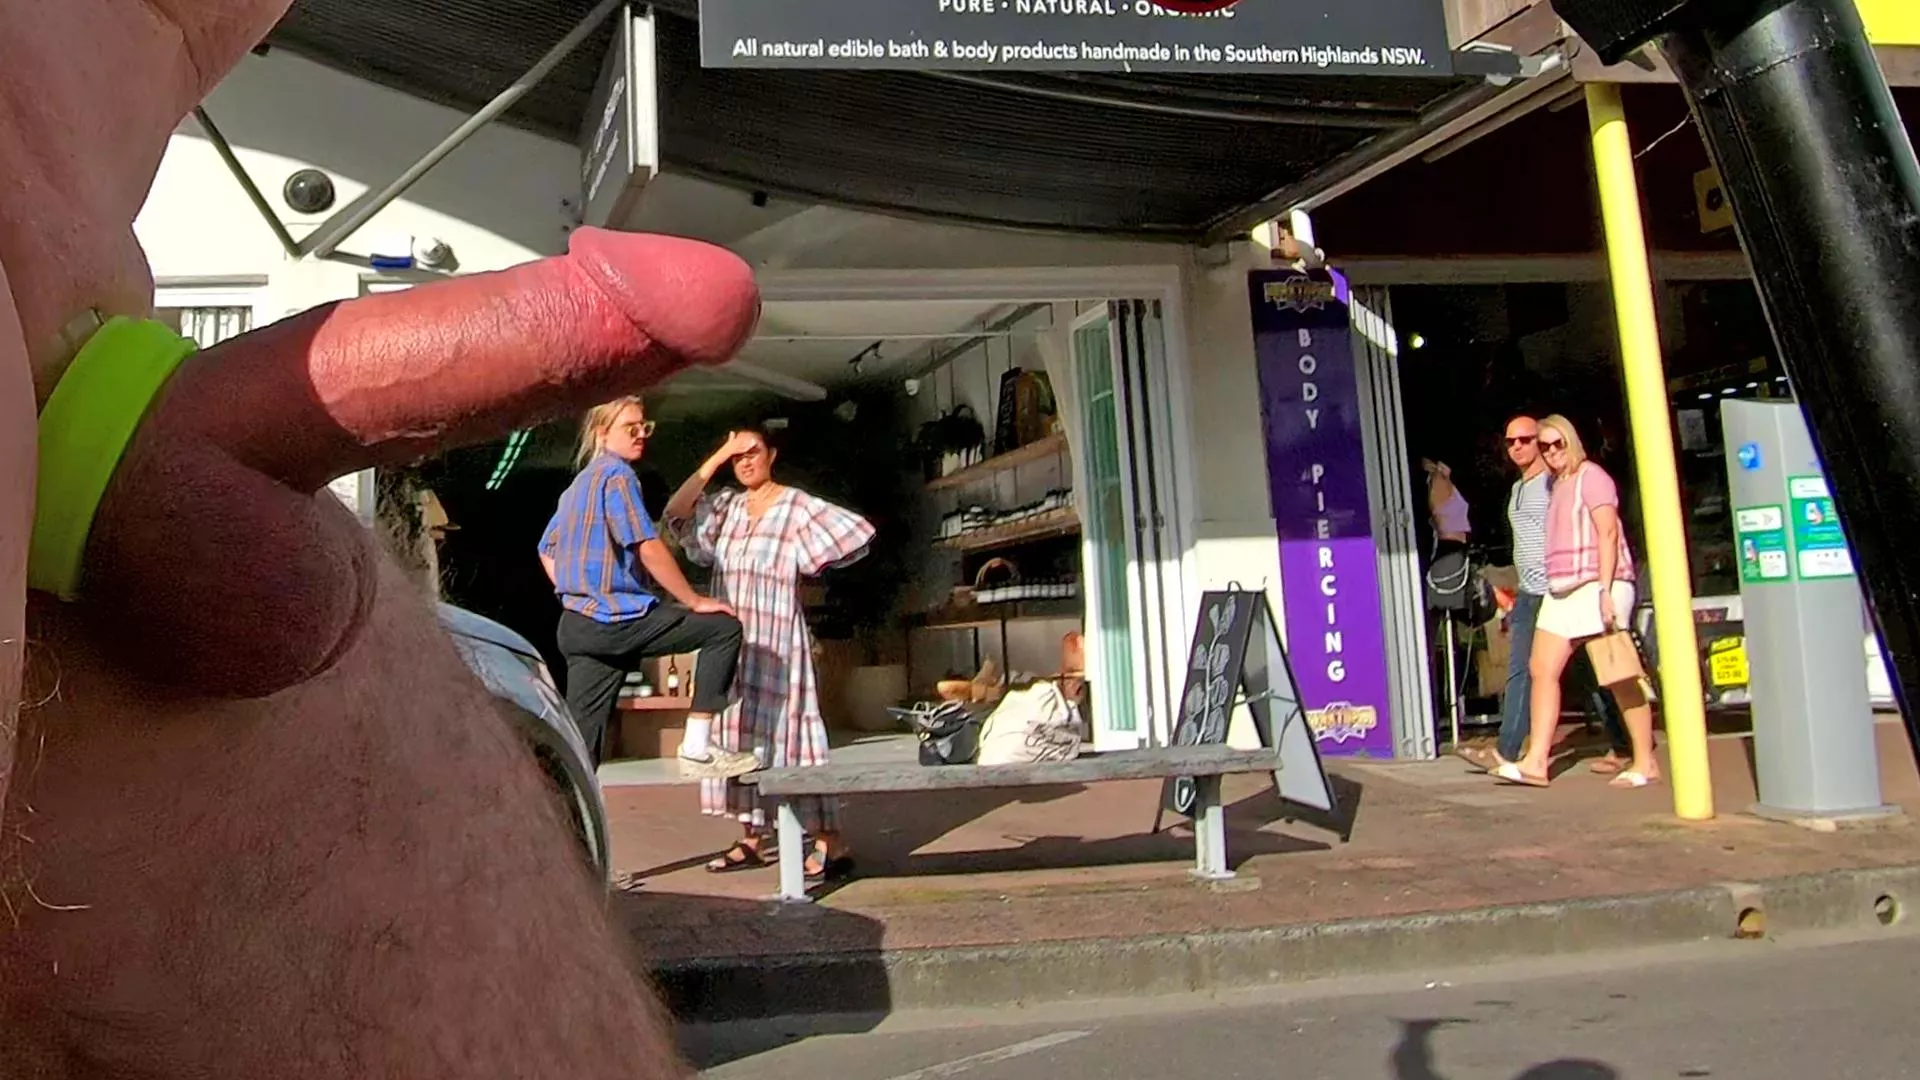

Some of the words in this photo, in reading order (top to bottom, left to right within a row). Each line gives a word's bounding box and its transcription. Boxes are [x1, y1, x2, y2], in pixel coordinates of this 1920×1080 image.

[939, 0, 995, 13] PURE
[1016, 0, 1116, 15] NATURAL
[732, 39, 757, 58] All
[761, 39, 824, 58] natural
[828, 39, 884, 58] edible
[888, 40, 929, 59] bath
[933, 42, 949, 59] &
[952, 40, 997, 63] body
[1002, 41, 1078, 63] products
[1081, 42, 1170, 61] handmade
[1174, 44, 1190, 61] in
[1193, 45, 1221, 62] the
[1225, 45, 1299, 64] Southern
[1301, 46, 1379, 68] Highlands
[1382, 48, 1426, 65] NSW.
[1298, 328, 1319, 429] BODY
[1311, 463, 1345, 683] PIERCING
